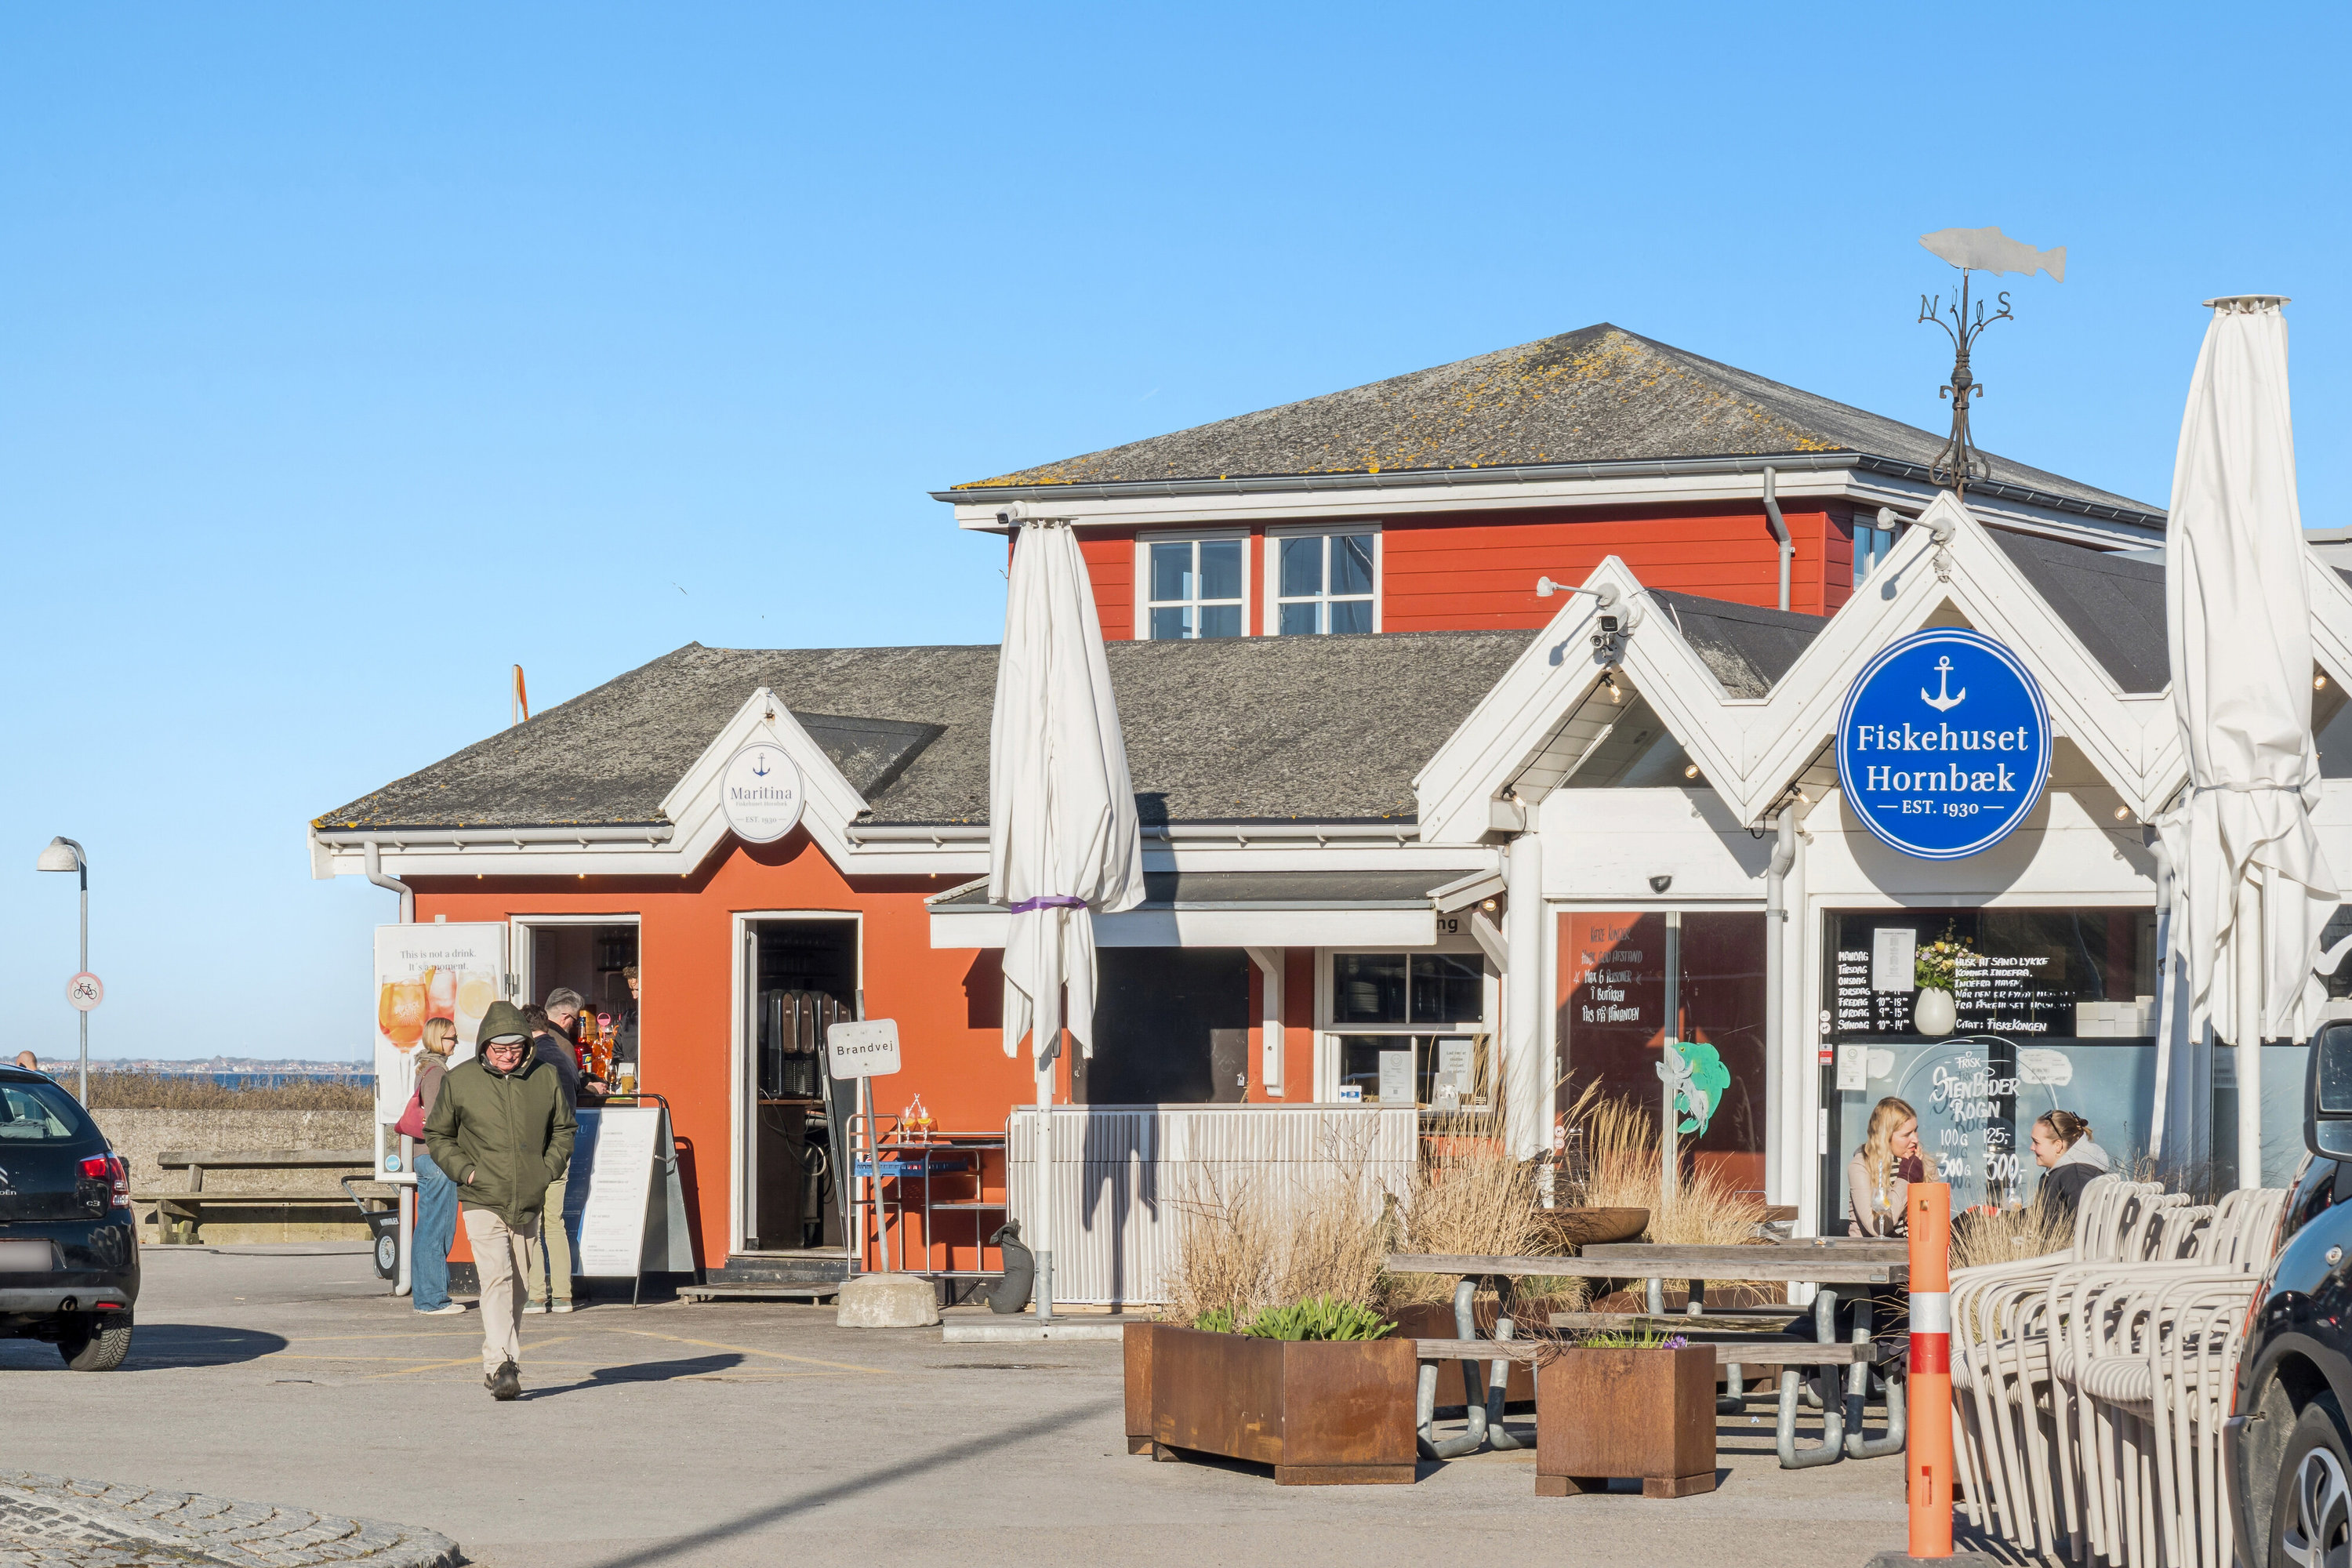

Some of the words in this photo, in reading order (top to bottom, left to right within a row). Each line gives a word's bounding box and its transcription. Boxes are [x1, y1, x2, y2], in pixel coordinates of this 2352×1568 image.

[1857, 722, 2029, 751] Fiskehuset
[1866, 762, 2016, 792] Hornbæk
[731, 786, 793, 800] Maritina
[1902, 800, 1936, 814] EST.
[1943, 802, 1979, 818] 1930
[400, 950, 418, 960] This
[420, 949, 427, 959] is
[429, 949, 443, 959] not
[452, 949, 477, 958] drink.
[1613, 949, 1642, 964] AFSTAND
[1838, 951, 1869, 962] MANDAG
[431, 962, 469, 972] moment.
[1955, 957, 1976, 967] HUSK
[1979, 957, 1991, 967] AT
[1991, 957, 2018, 967] SAND
[2020, 957, 2050, 966] LYKKE
[1599, 969, 1604, 984] 6
[1955, 969, 1988, 978] KOMMER
[1838, 977, 1867, 985] ONSDAG
[1838, 987, 1871, 996] TORSDAG
[1955, 989, 1972, 998] NÅR
[1838, 997, 1869, 1007] FREDAG
[1955, 1000, 1972, 1009] FRA
[1582, 1004, 1594, 1022] PAS
[1597, 1005, 1606, 1022] PÅ
[1838, 1008, 1870, 1018] LØRDAG
[1838, 1019, 1870, 1030] SØNDAG
[837, 1040, 893, 1055] Brandvej
[1950, 1099, 2000, 1122] ROGN
